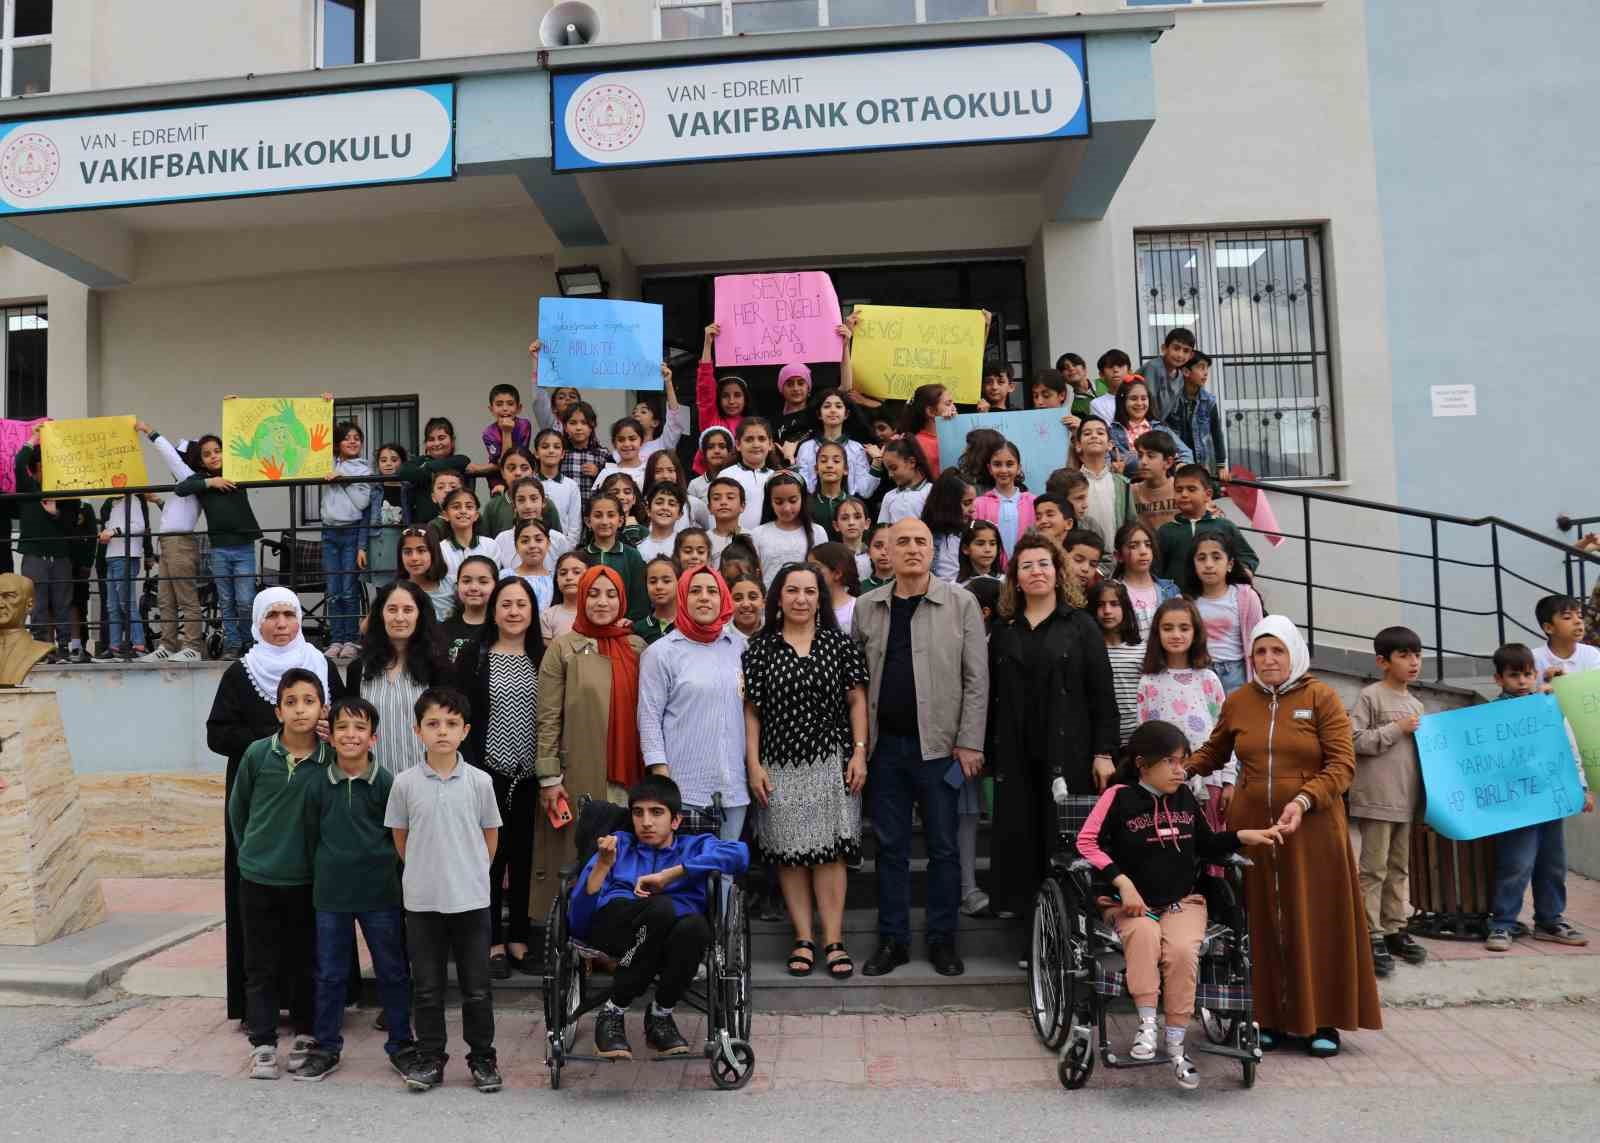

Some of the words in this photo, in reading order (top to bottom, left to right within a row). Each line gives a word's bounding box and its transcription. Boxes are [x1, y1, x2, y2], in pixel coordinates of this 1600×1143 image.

[667, 84, 706, 103] VAN
[724, 77, 803, 99] EDREMİT
[668, 101, 848, 138] VAKIFBANK
[856, 88, 1052, 125] ORTAOKULU
[80, 133, 116, 151] VAN
[133, 124, 209, 147] EDREMİT
[79, 147, 249, 185] VAKIFBANK
[257, 132, 412, 171] İLKOKULU
[735, 302, 765, 326] HER
